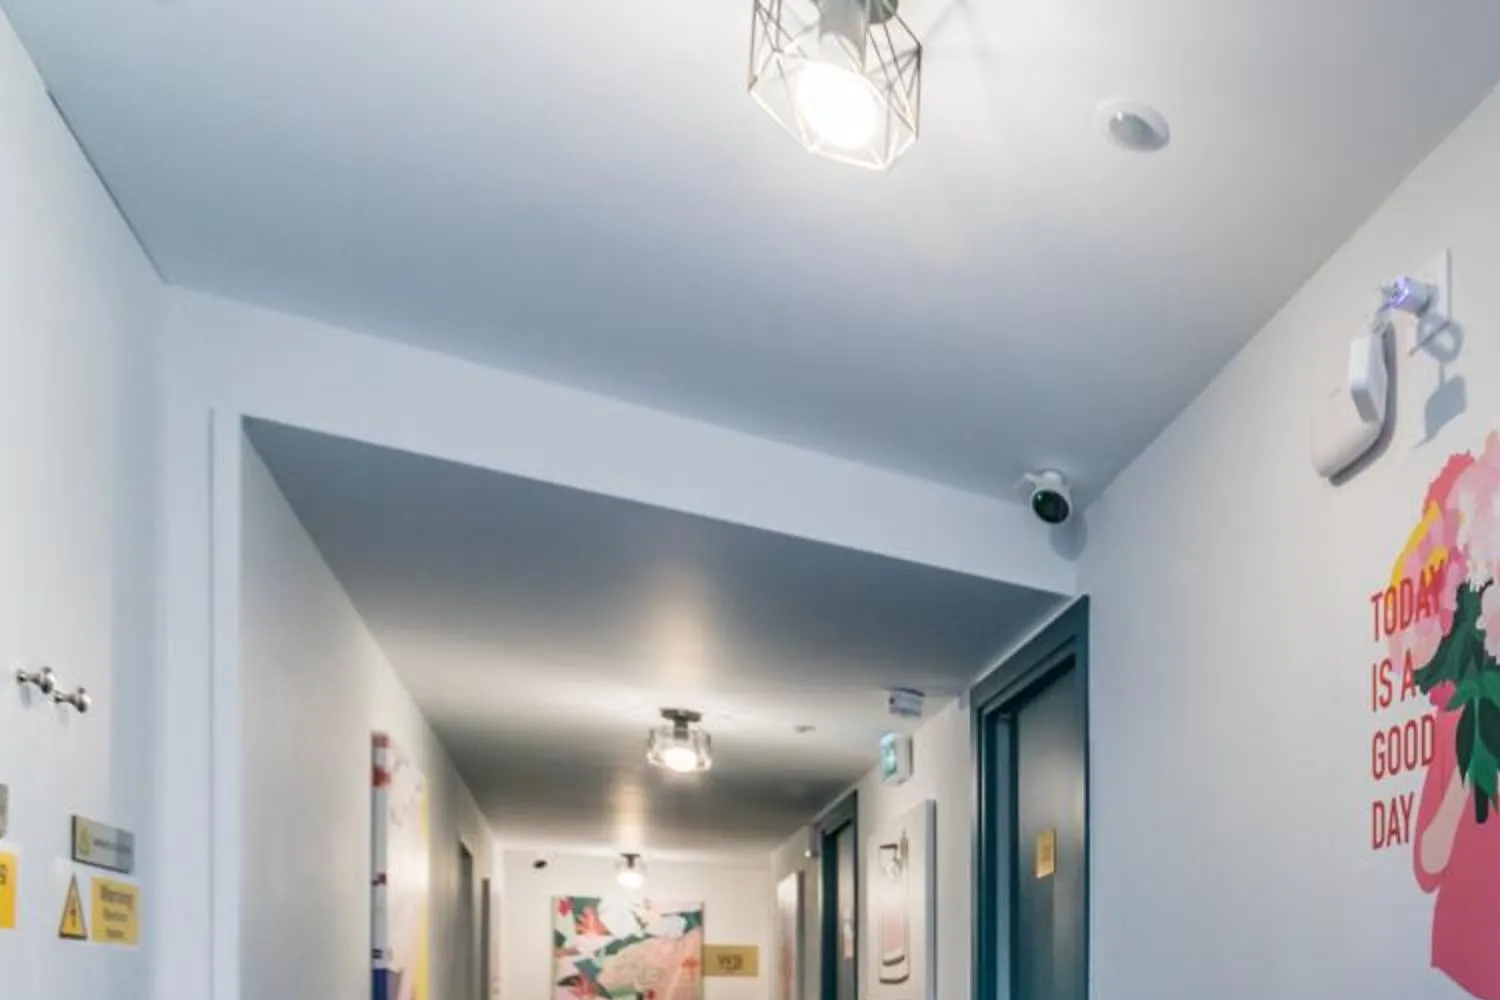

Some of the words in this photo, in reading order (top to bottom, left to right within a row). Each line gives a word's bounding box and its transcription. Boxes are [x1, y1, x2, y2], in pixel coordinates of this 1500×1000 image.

[1370, 559, 1444, 642] TODAY
[1372, 657, 1393, 713] IS
[1401, 649, 1417, 703] A
[1371, 714, 1435, 780] GOOD
[1372, 791, 1414, 851] DAY
